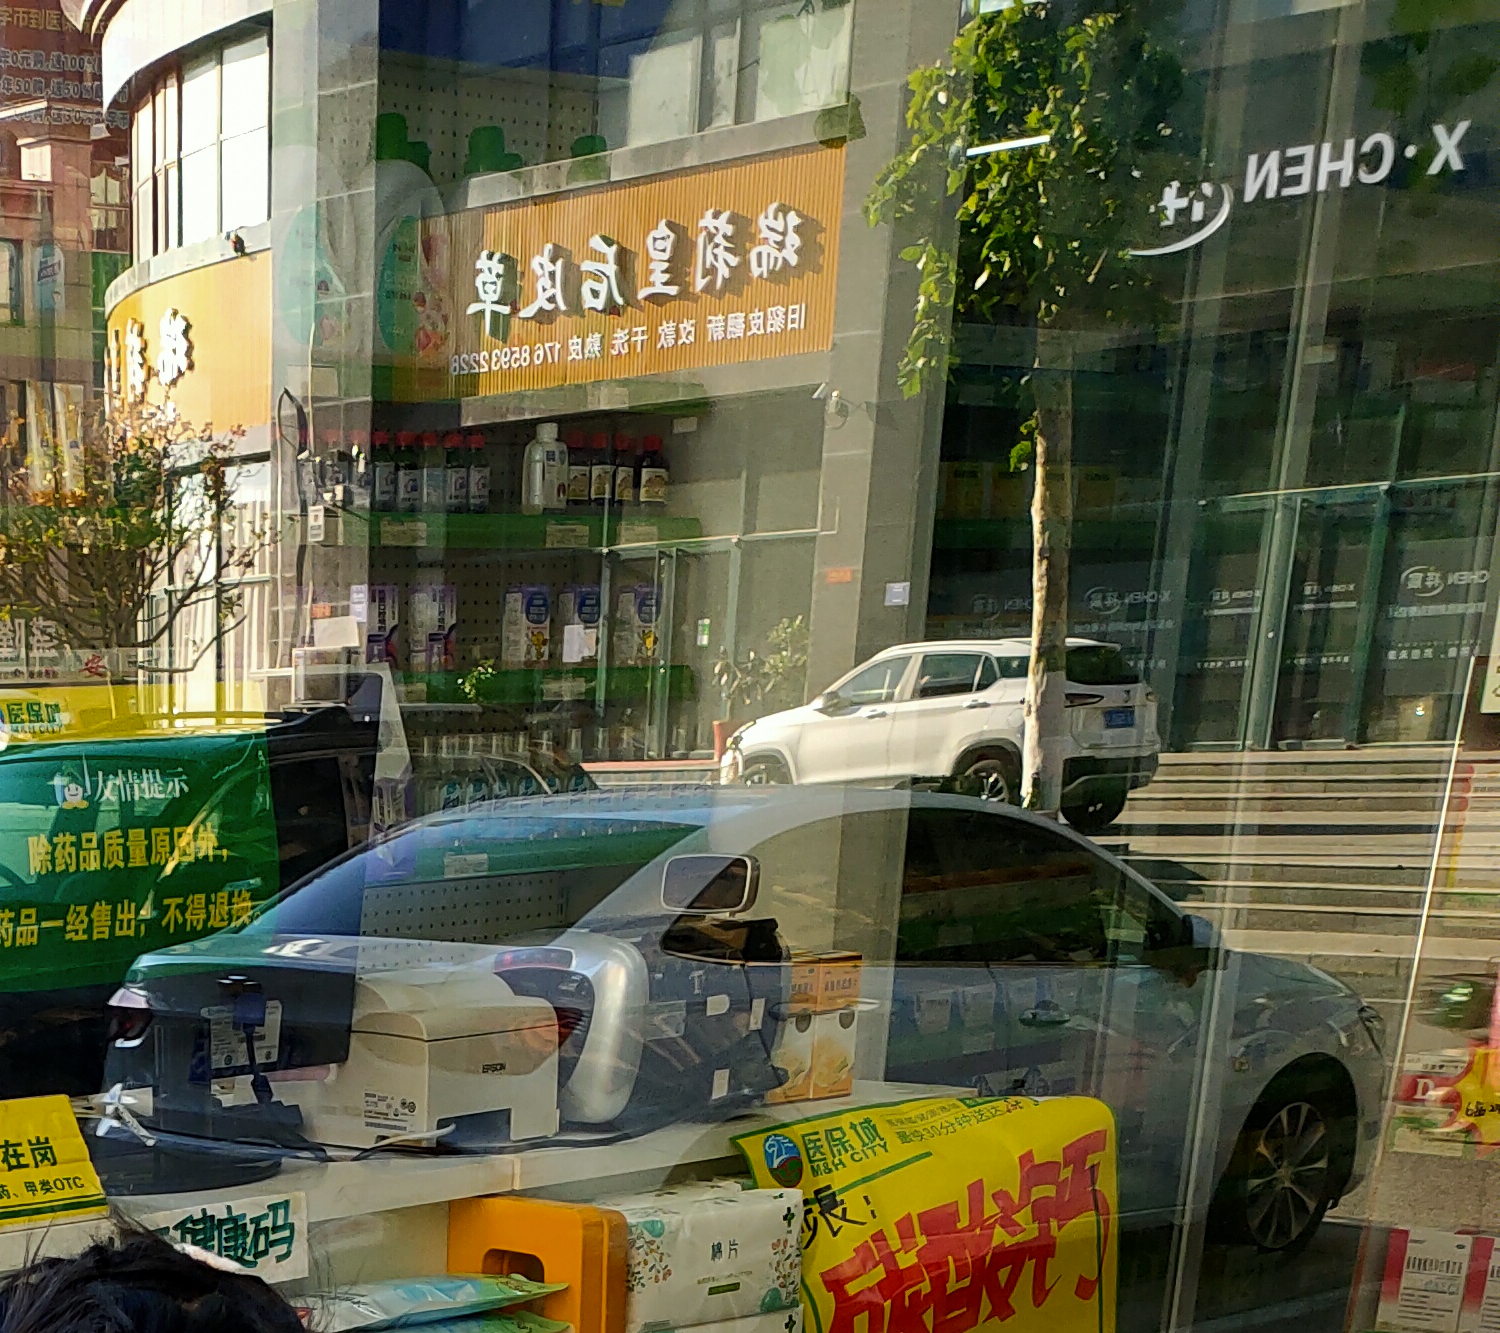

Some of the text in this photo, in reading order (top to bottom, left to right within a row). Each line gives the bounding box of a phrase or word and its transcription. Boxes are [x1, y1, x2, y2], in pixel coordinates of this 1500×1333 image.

[93, 768, 190, 802] 友情提示
[801, 1117, 886, 1167] 医保城
[810, 1142, 890, 1179] M&H CITY
